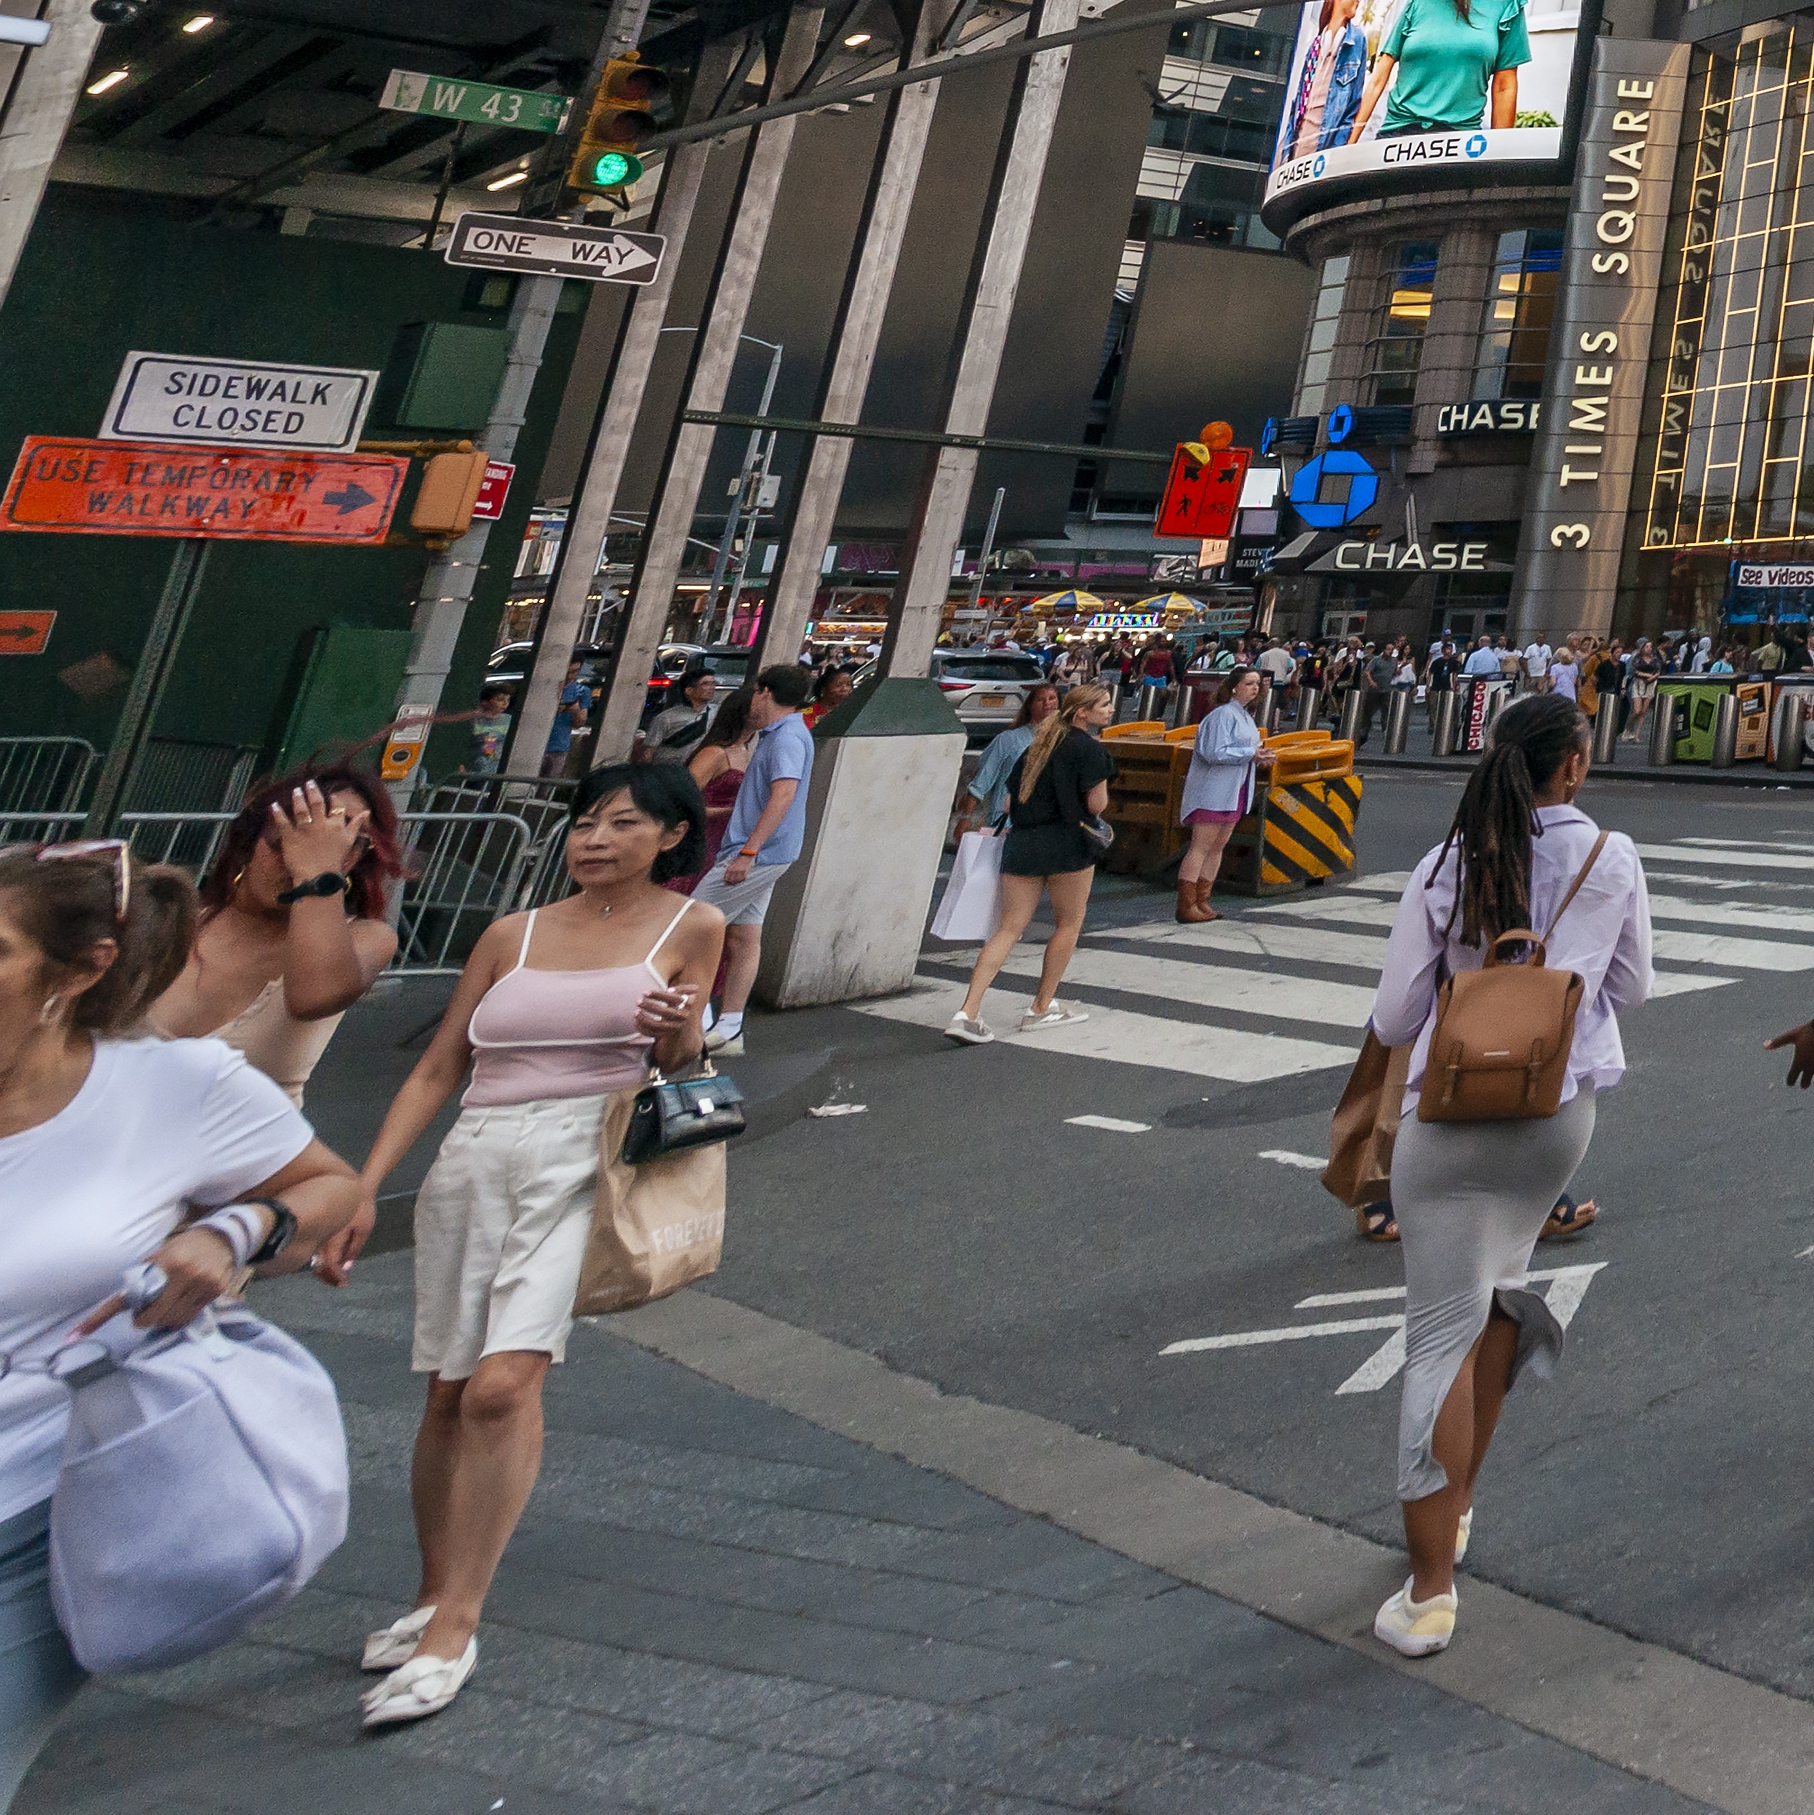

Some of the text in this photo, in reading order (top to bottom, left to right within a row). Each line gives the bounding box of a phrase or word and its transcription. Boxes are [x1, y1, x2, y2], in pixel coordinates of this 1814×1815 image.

[432, 82, 467, 114] W
[480, 91, 523, 123] 43
[1384, 138, 1461, 163] CHASE
[1276, 159, 1313, 189] CHASE
[473, 231, 635, 266] ONE WAY
[1550, 78, 1655, 550] 3 TIMES SQUARE
[164, 371, 334, 406] SIDEWALK
[172, 404, 306, 434] CLOSED
[36, 457, 323, 494] USE TEMPORARY
[85, 490, 259, 520] WALKWAY
[1242, 548, 1271, 558] STEV
[1334, 542, 1489, 571] CHASE
[1467, 680, 1488, 751] CHICAGO
